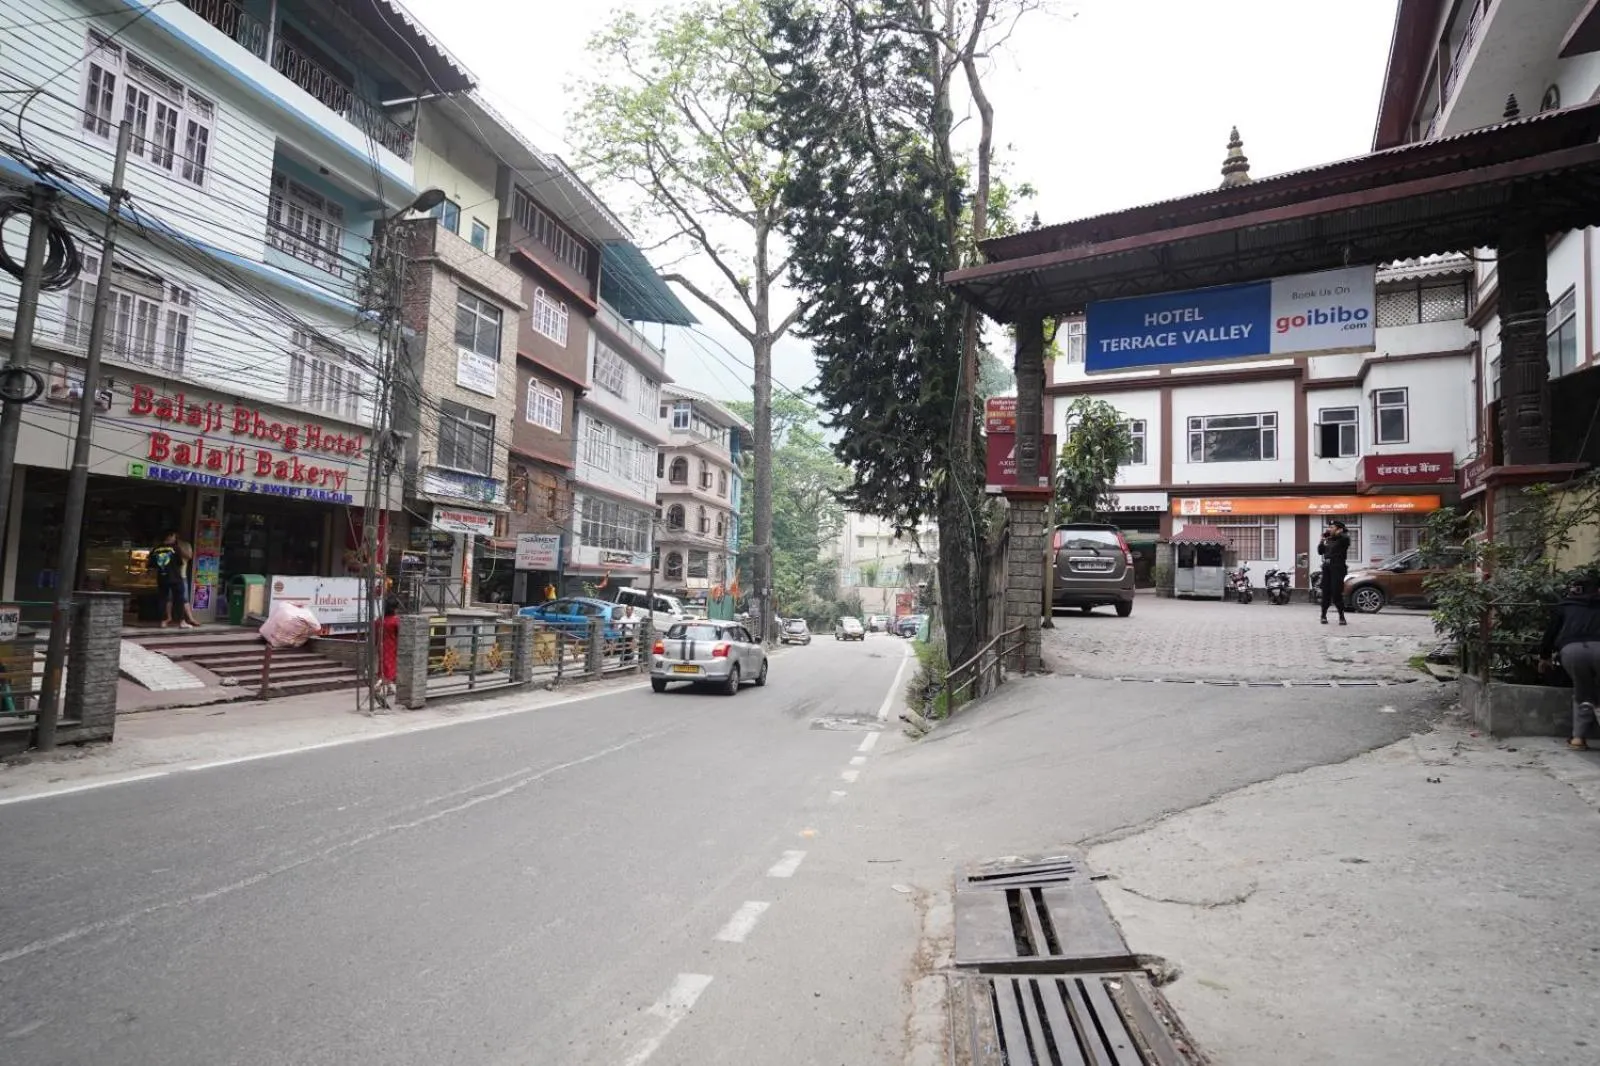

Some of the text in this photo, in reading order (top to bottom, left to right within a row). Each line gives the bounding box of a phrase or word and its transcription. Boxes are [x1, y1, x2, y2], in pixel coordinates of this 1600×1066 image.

[1292, 285, 1350, 300] Book Us On
[1144, 305, 1369, 333] HOTEL goibibo
[1100, 324, 1253, 352] TERRACE VALLEY
[129, 383, 364, 459] Balaji Bhog Hotel
[147, 430, 348, 493] Balaji Bakery
[147, 466, 244, 490] RESTAURANT
[263, 484, 302, 498] SWEET
[306, 488, 353, 505] PARLOUR
